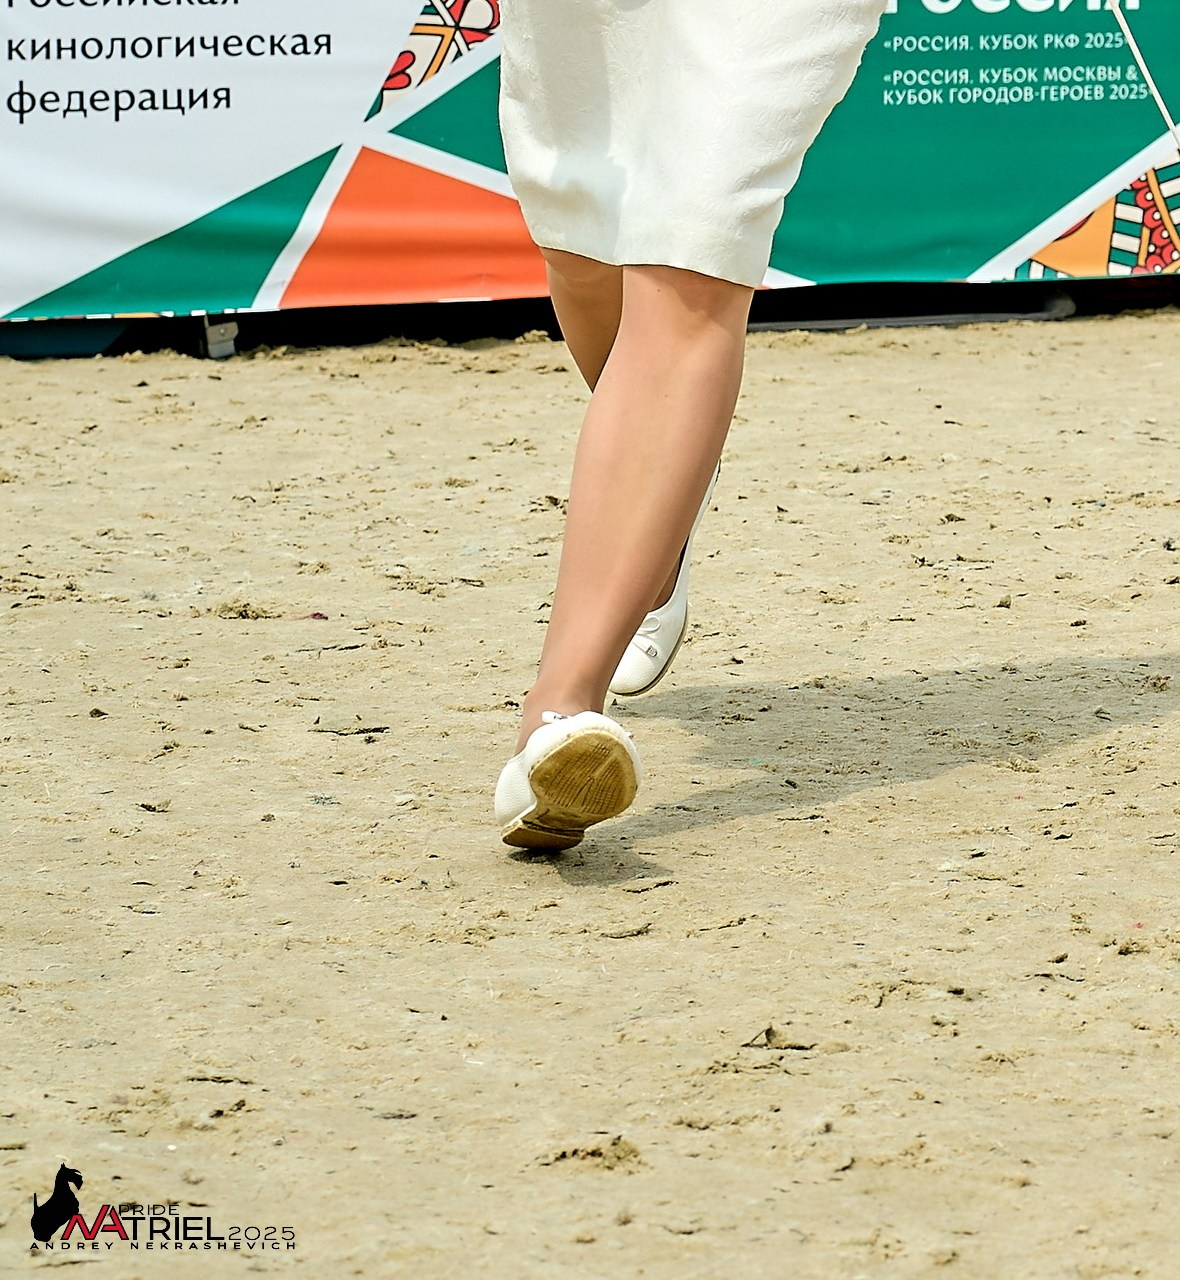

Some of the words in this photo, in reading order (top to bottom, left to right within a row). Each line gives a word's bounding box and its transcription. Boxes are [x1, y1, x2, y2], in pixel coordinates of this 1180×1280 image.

[7, 34, 332, 61] кинологическая
[979, 34, 1039, 50] КУБОК
[1043, 33, 1079, 49] РКФ
[979, 67, 1039, 84] КУБОК
[1043, 65, 1121, 82] МОСКВЫ
[1125, 65, 1139, 81] &
[6, 80, 232, 124] федерация
[883, 88, 943, 105] КУБОК
[949, 84, 1105, 105] ГОРОДОВ-ГЕРОЕВ
